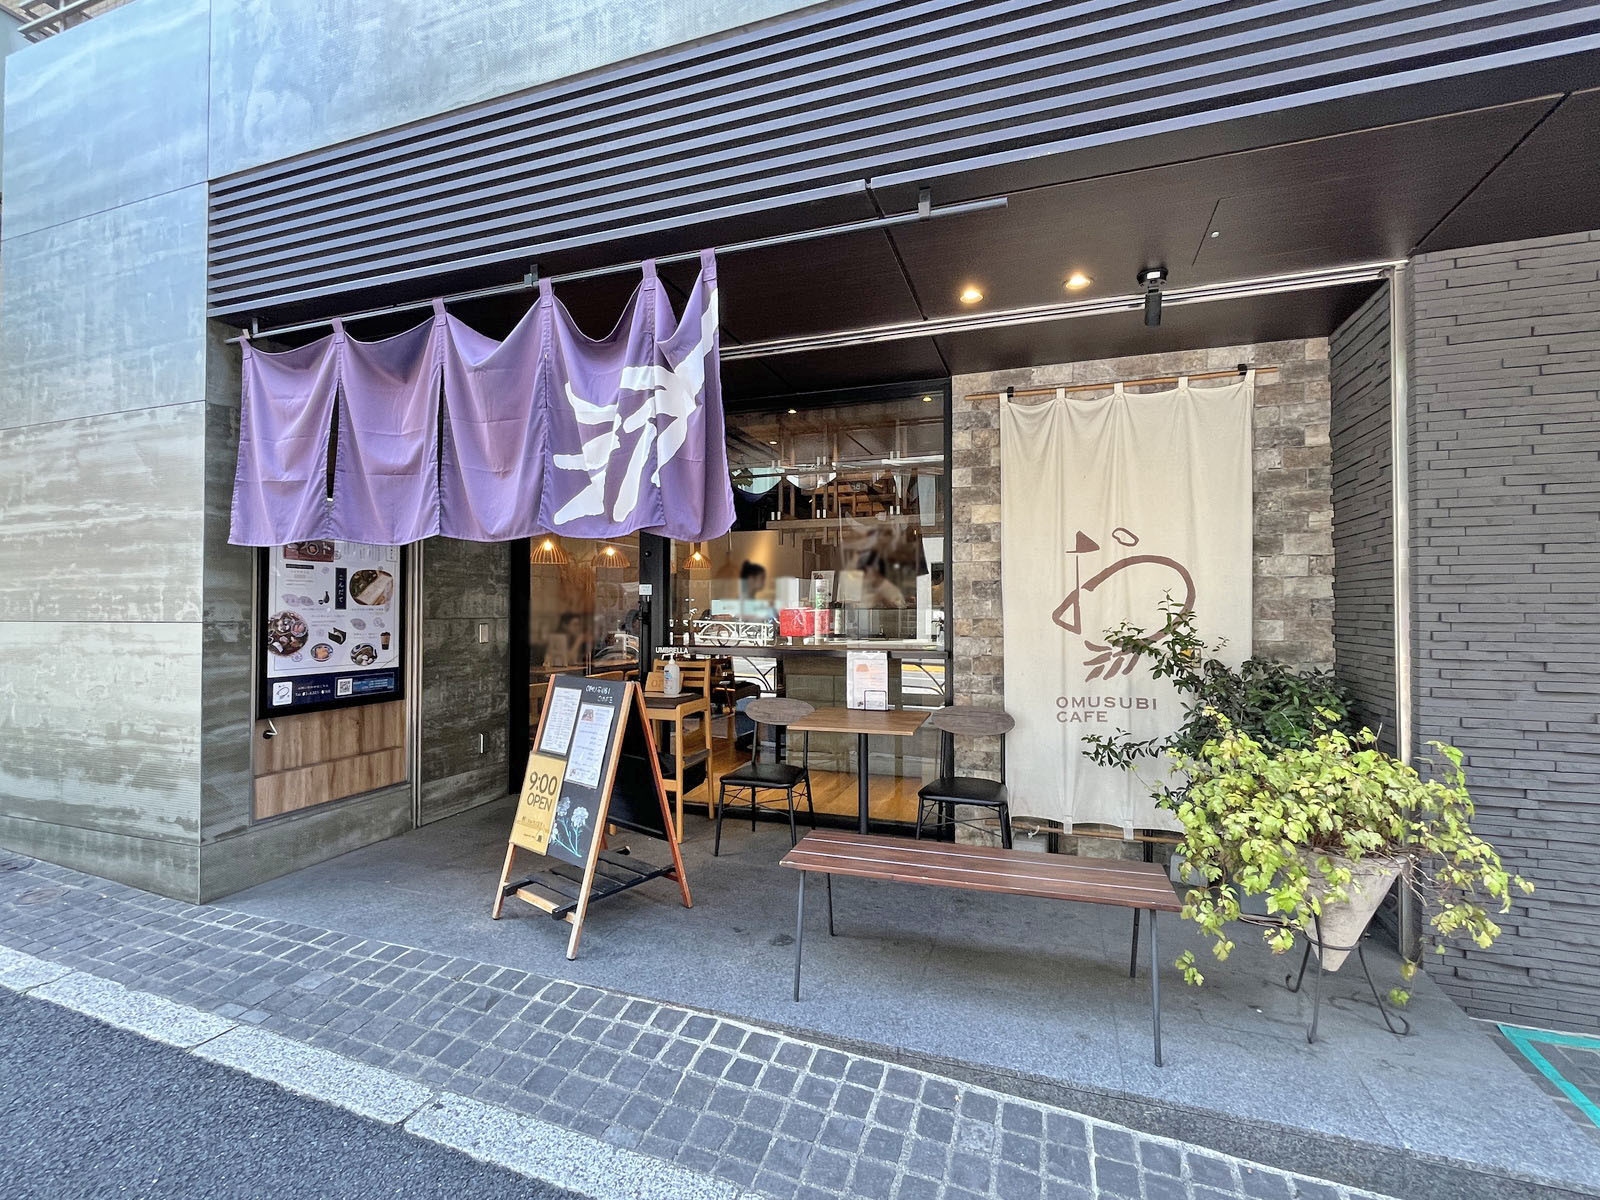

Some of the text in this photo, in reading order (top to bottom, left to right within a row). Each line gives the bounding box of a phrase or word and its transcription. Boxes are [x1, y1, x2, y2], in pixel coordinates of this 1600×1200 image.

[655, 646, 689, 654] UMBRELLA
[1056, 696, 1157, 710] OMUSUBI
[1056, 711, 1108, 723] CAFE
[528, 771, 558, 796] 9:00
[526, 792, 553, 812] OPEN
